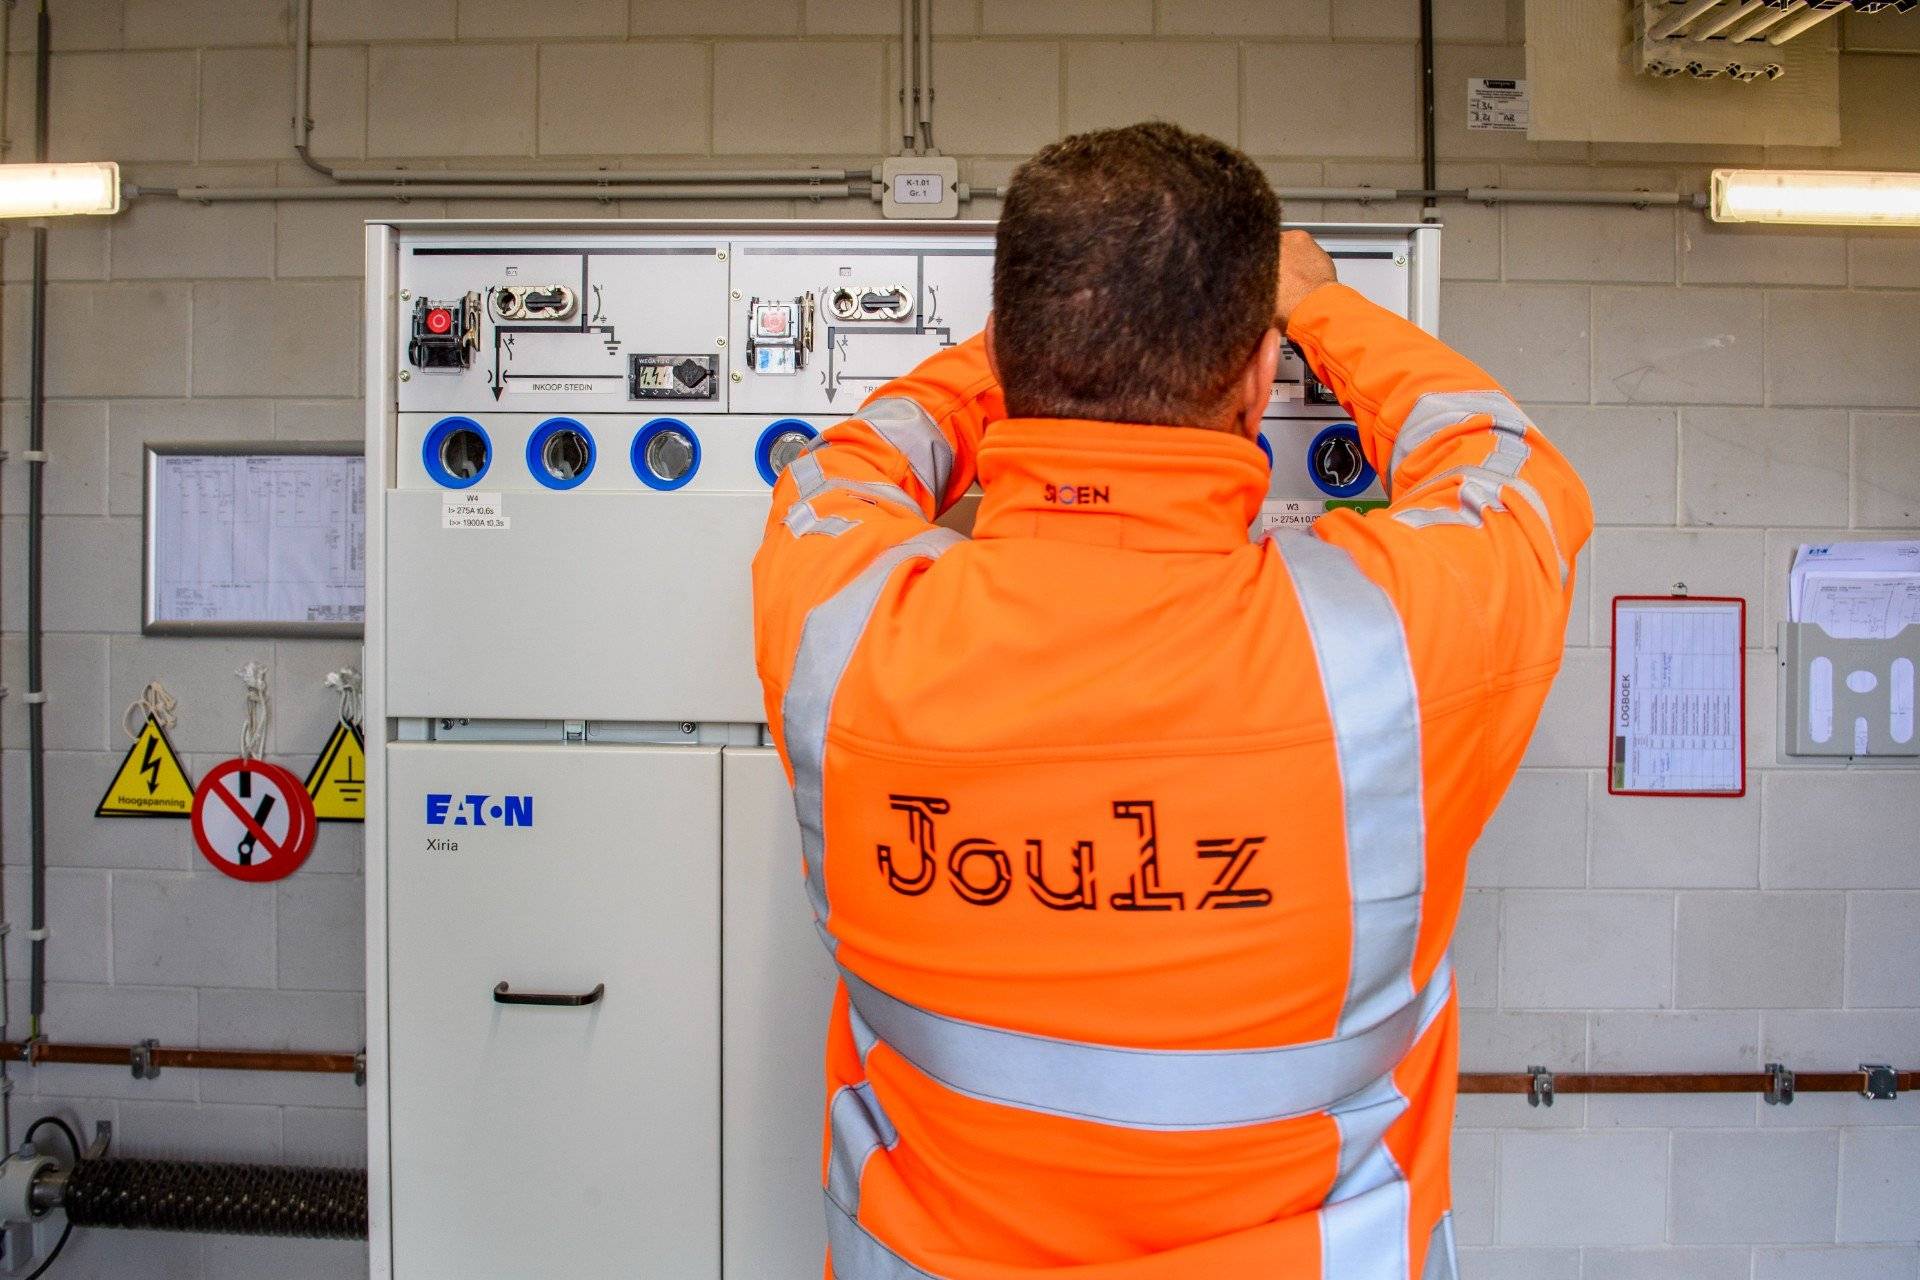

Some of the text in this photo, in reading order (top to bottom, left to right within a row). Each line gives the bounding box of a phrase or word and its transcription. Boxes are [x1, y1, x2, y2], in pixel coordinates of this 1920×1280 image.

[532, 383, 593, 391] INKOOP STEDIN
[1286, 503, 1299, 511] W3
[1280, 516, 1300, 524] 275A
[1620, 673, 1631, 728] LOGBOEK
[118, 795, 186, 809] Hoogspanning
[426, 793, 533, 827] EATON
[426, 838, 459, 851] Xiria
[876, 793, 1274, 911] Joulz
